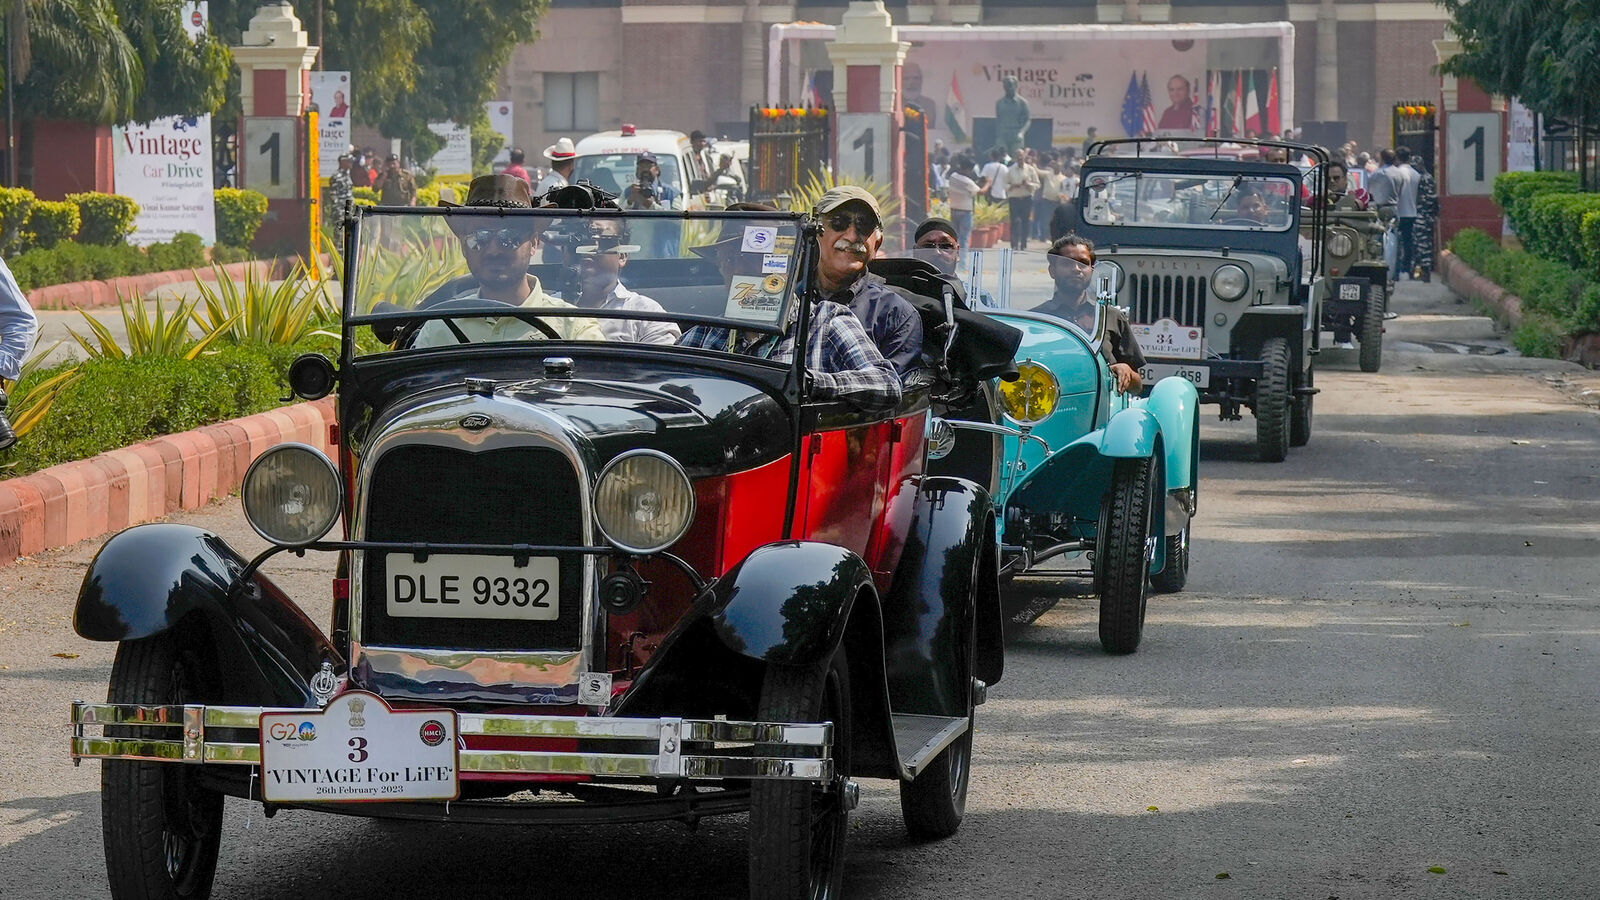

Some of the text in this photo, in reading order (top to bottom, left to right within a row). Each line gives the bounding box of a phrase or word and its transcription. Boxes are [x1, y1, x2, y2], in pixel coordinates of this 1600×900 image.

[1018, 84, 1096, 98] Car Drive
[124, 131, 202, 160] Vintage
[853, 127, 874, 182] 1
[1463, 126, 1485, 181] 1
[143, 162, 204, 178] Car Drive
[260, 132, 280, 186] 1
[1156, 334, 1173, 344] 34
[463, 416, 488, 427] Ford
[394, 574, 550, 608] DLE 9332
[348, 736, 369, 763] 3
[272, 766, 449, 784] VINTAGE For LiFE
[316, 784, 404, 796] 26th February 2023
